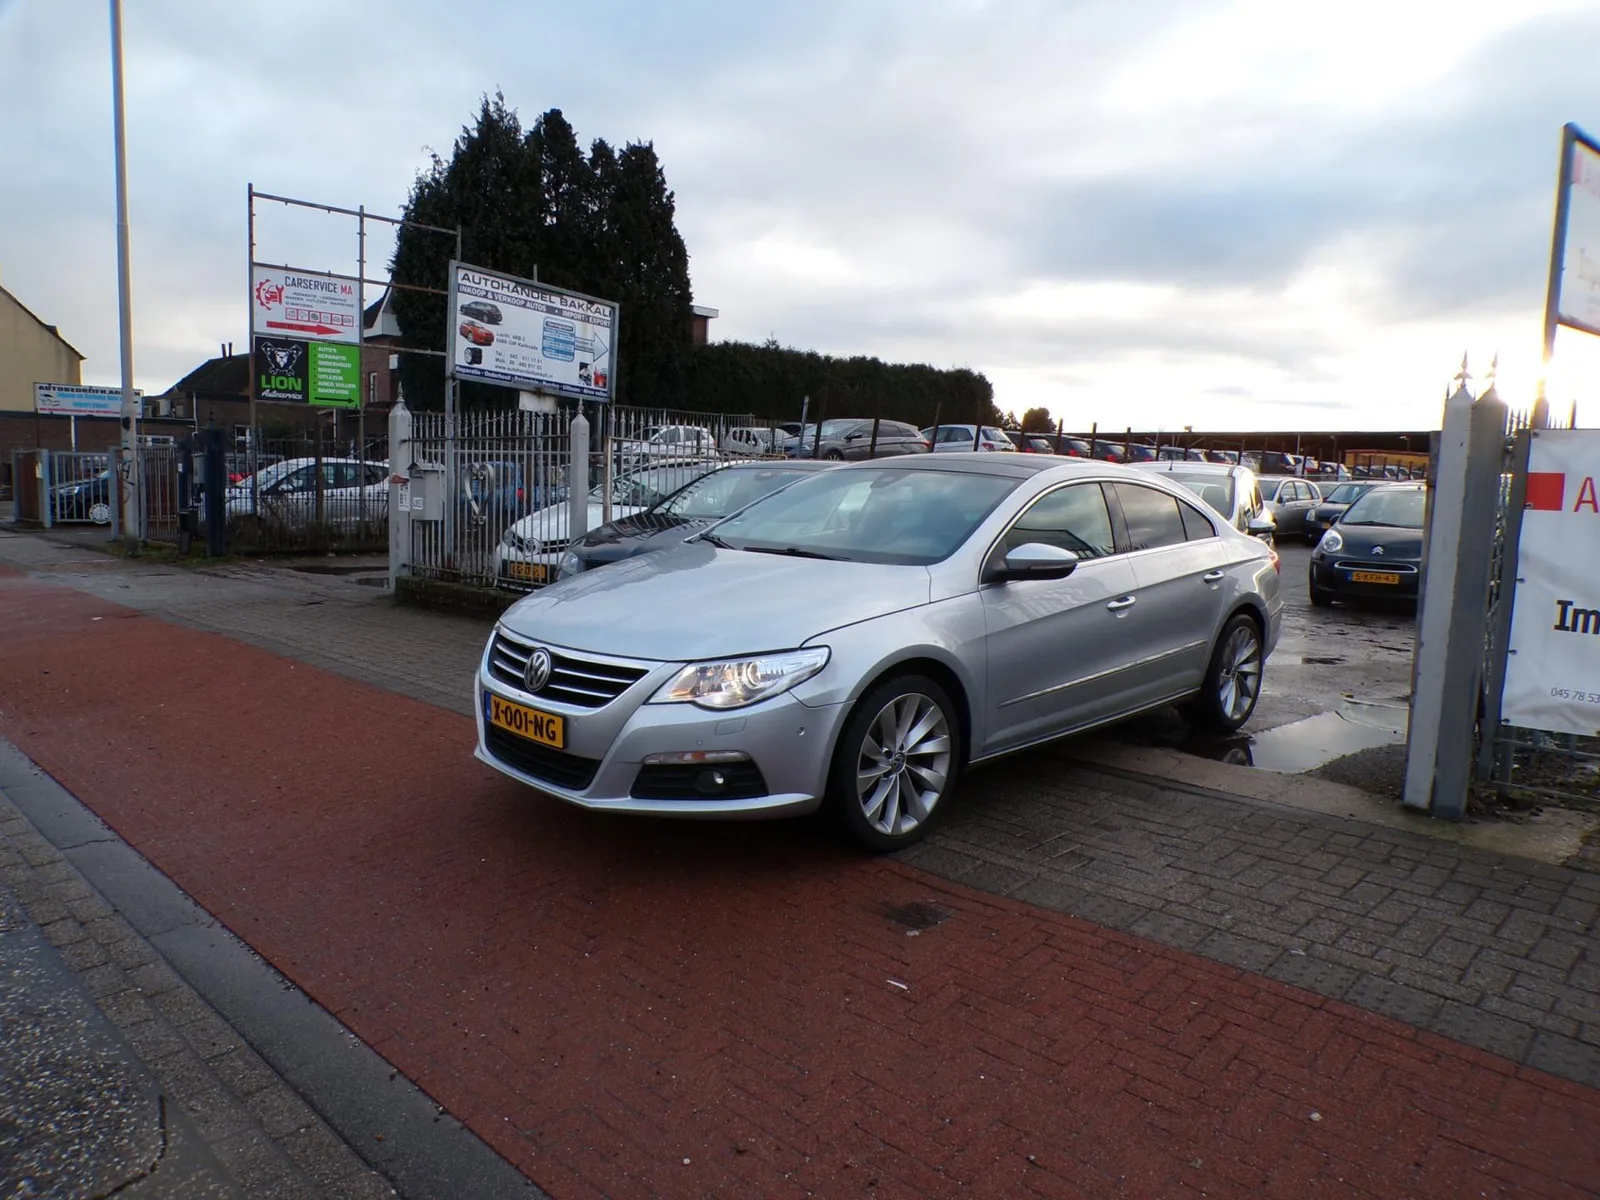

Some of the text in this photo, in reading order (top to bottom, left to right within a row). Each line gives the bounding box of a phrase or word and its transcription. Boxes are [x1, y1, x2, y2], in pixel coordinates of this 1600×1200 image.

[284, 276, 353, 295] CARSERVICE MA
[461, 273, 612, 317] AUTOHANDEL BAKKALI
[459, 285, 486, 297] INKOOP
[494, 292, 525, 306] VERKOOP
[526, 301, 547, 312] AUTOS
[562, 310, 585, 321] IMPORT
[588, 315, 611, 328] EXPORT
[455, 365, 481, 376] Reparatie
[484, 370, 511, 381] Onderhoud
[261, 374, 302, 391] LION
[261, 388, 303, 400] Autoservice
[1354, 572, 1396, 583] 5-KFH-43
[1550, 687, 1570, 699] 045
[1571, 690, 1585, 701] 78
[493, 699, 556, 741] X-001-NG
